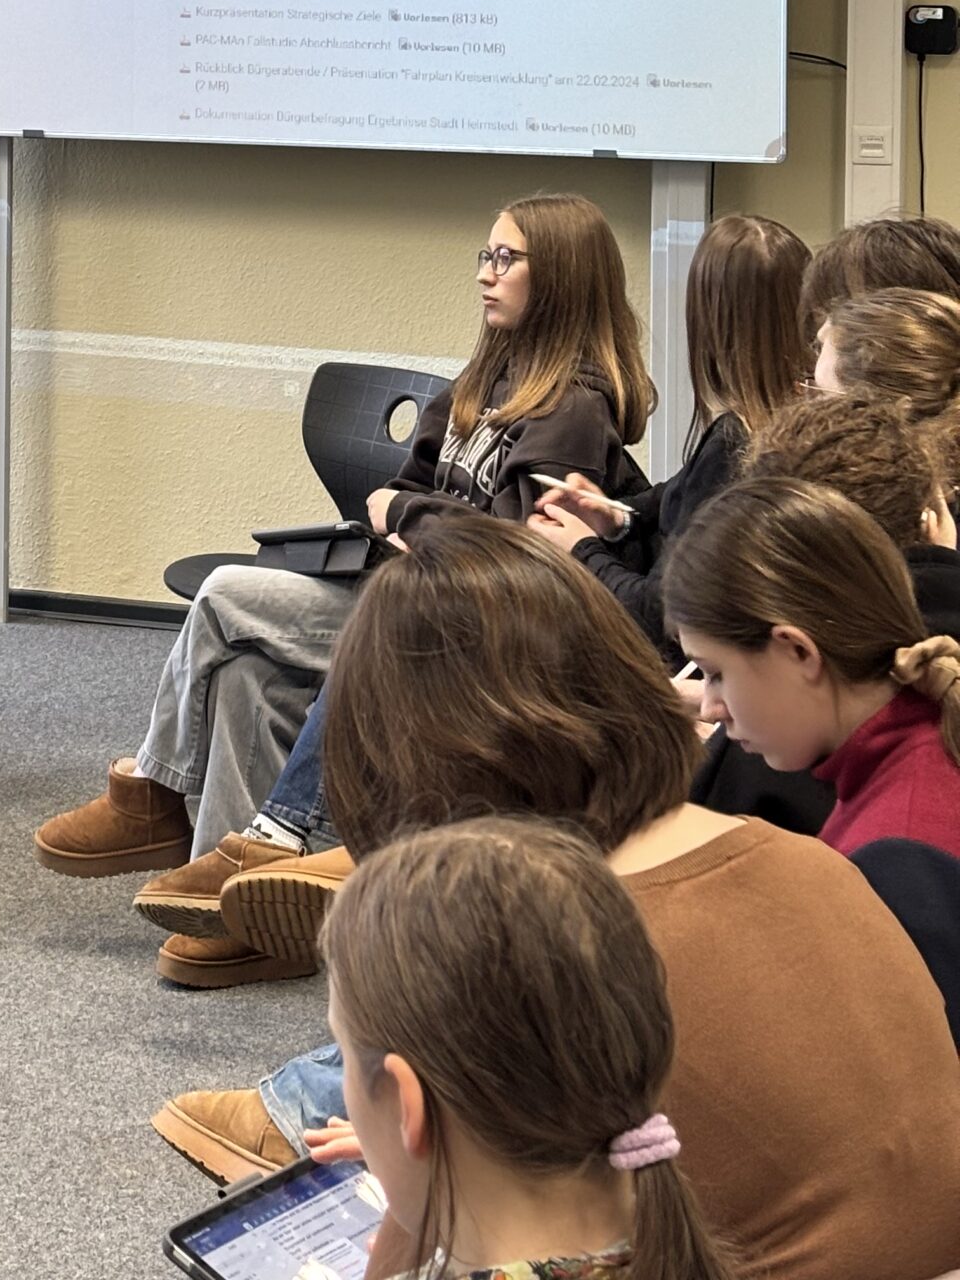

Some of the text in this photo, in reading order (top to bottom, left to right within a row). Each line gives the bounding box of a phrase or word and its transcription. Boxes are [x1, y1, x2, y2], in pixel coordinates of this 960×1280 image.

[196, 6, 498, 26] Kurzpräsentation Strategische Ziele Vorlesen (813 kB)
[248, 36, 298, 48] Fallstudie
[300, 37, 392, 51] Abschlussbericht
[414, 42, 459, 53] Vorlesen
[462, 42, 481, 55] (10
[484, 43, 506, 56] MB)
[195, 62, 245, 75] Rückblick
[248, 63, 320, 77] Bürgerabende
[330, 66, 398, 79] Präsentation
[401, 67, 452, 82] "Fahrplan
[554, 77, 573, 86] am
[576, 75, 639, 88] 22.02.2024
[663, 78, 712, 89] Vorlesen
[209, 80, 230, 93] MB)
[195, 108, 636, 137] Dokumentation Bürgerbefragung Ergebnisse Stadt Helmstedt Vorlesen (10 MB)
